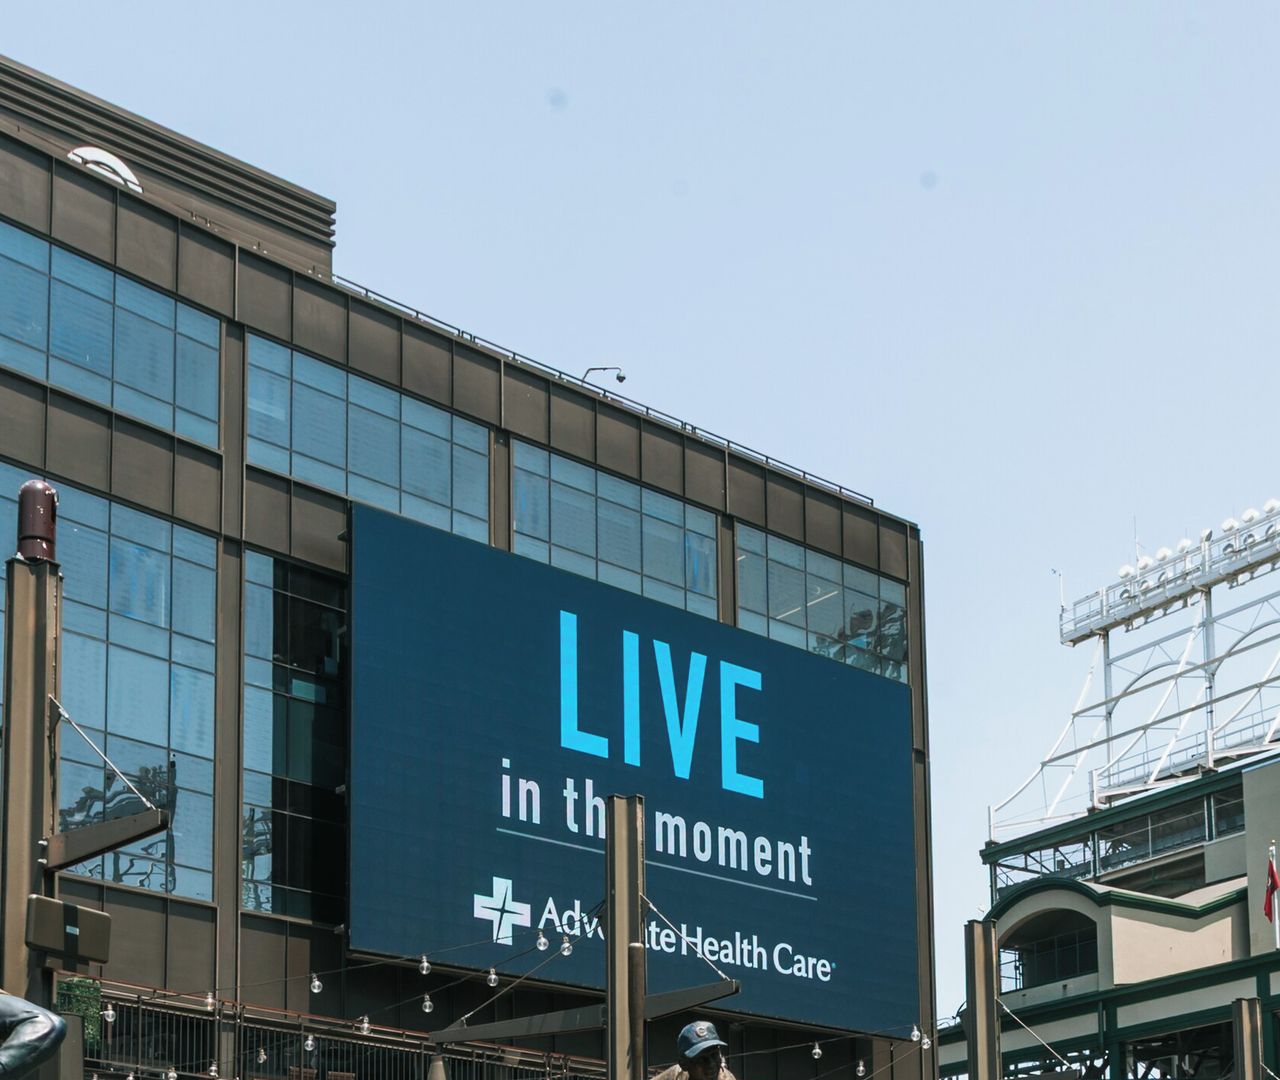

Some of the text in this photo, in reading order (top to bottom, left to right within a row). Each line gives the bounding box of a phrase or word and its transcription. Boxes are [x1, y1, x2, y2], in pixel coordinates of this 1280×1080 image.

[560, 610, 763, 798] LIVE
[502, 758, 812, 886] in th moment
[680, 924, 767, 970] Health
[773, 943, 831, 981] Care
